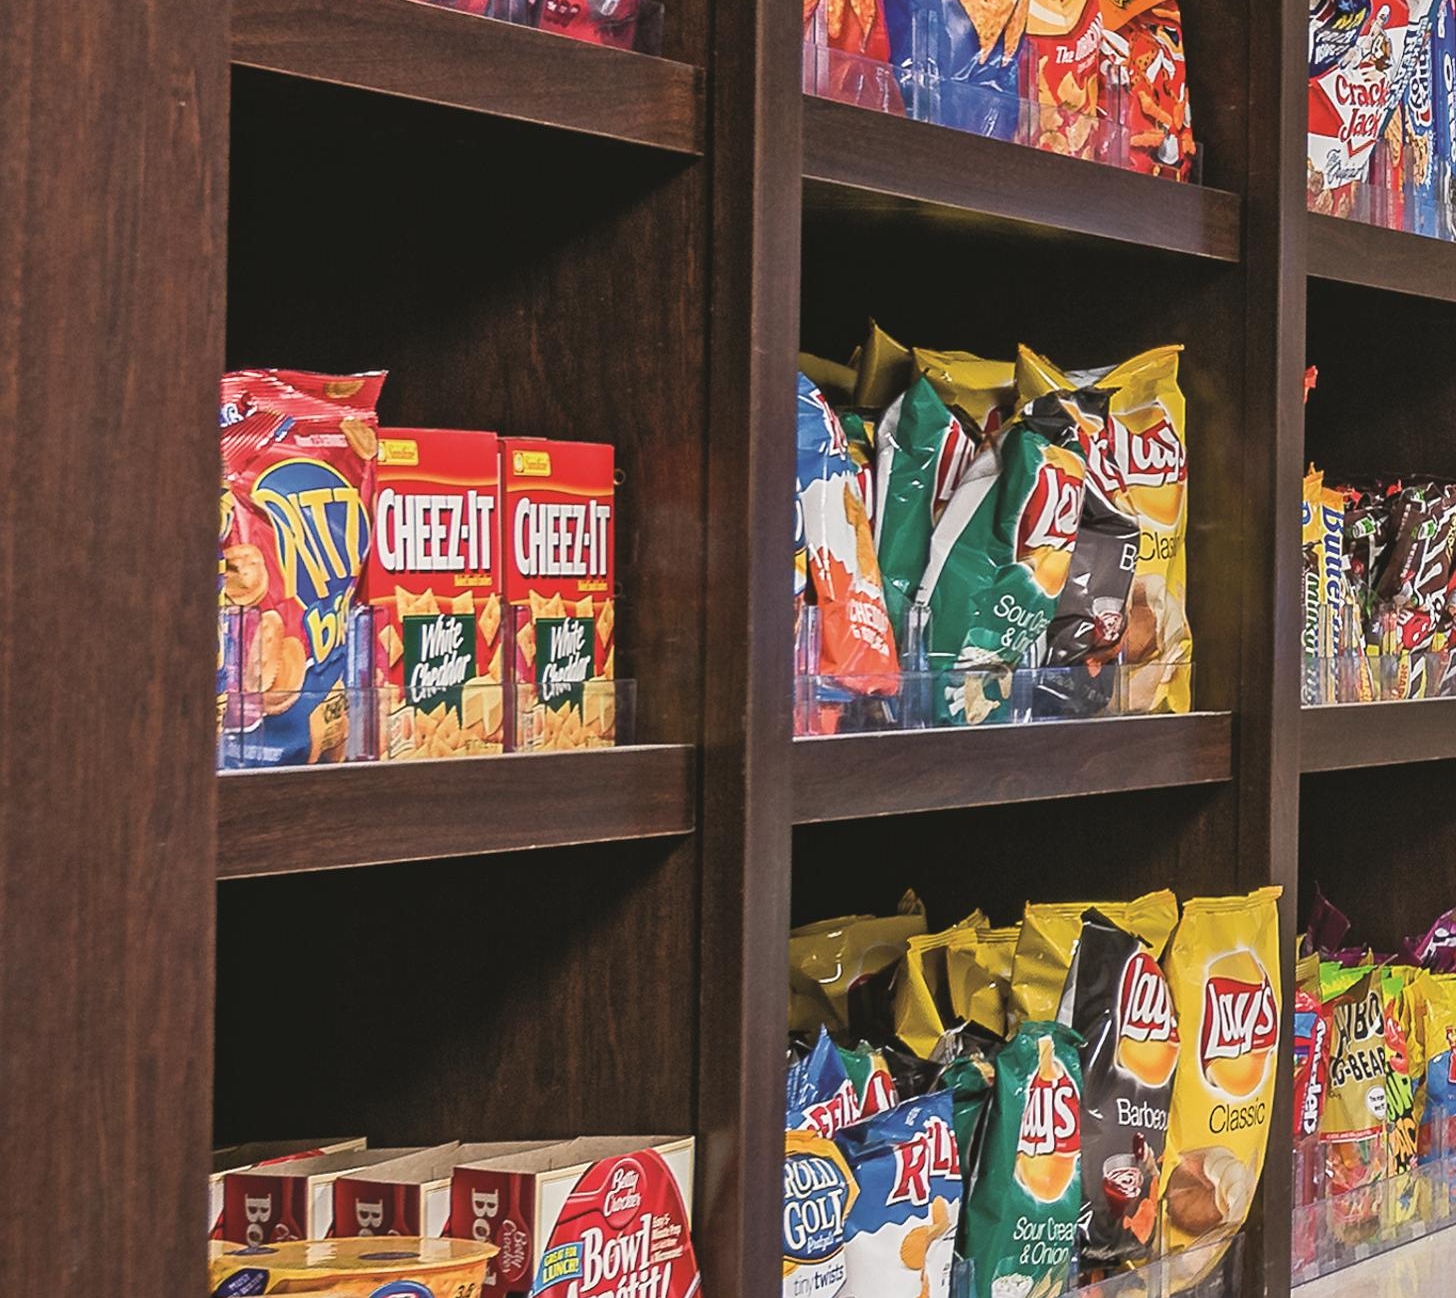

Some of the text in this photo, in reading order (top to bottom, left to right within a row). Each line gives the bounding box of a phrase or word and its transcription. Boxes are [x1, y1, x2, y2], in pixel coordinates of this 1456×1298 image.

[378, 489, 494, 572] CHEEZ-IT
[515, 498, 610, 577] CHEEZ-IT
[421, 618, 463, 662] White
[551, 618, 587, 662] White
[410, 652, 472, 703] Cheddar
[1204, 976, 1277, 1059] Lay's
[1208, 1102, 1266, 1135] Classic
[611, 1169, 642, 1193] Betty
[542, 1255, 581, 1285] LUNCH!
[581, 1214, 653, 1290] Bowl
[814, 1264, 844, 1289] twists
